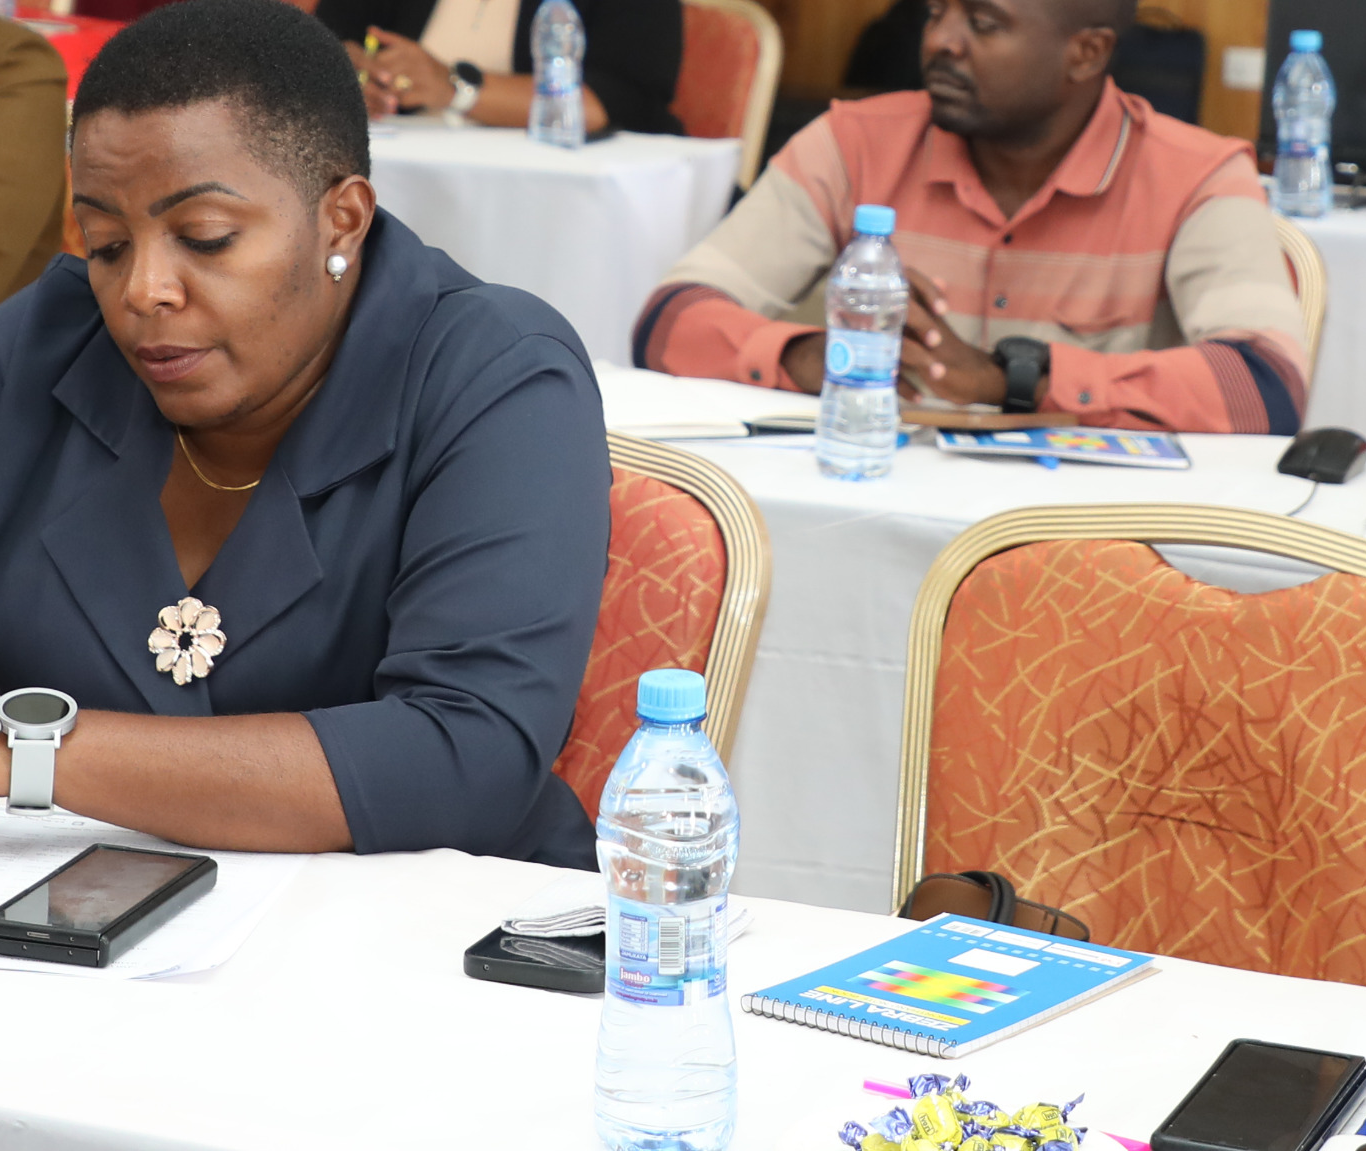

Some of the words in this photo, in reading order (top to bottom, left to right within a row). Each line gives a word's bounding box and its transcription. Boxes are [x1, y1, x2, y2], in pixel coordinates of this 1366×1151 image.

[798, 990, 864, 1009] LINE
[867, 1005, 959, 1031] ZEBRA
[919, 1114, 933, 1134] Ivori
